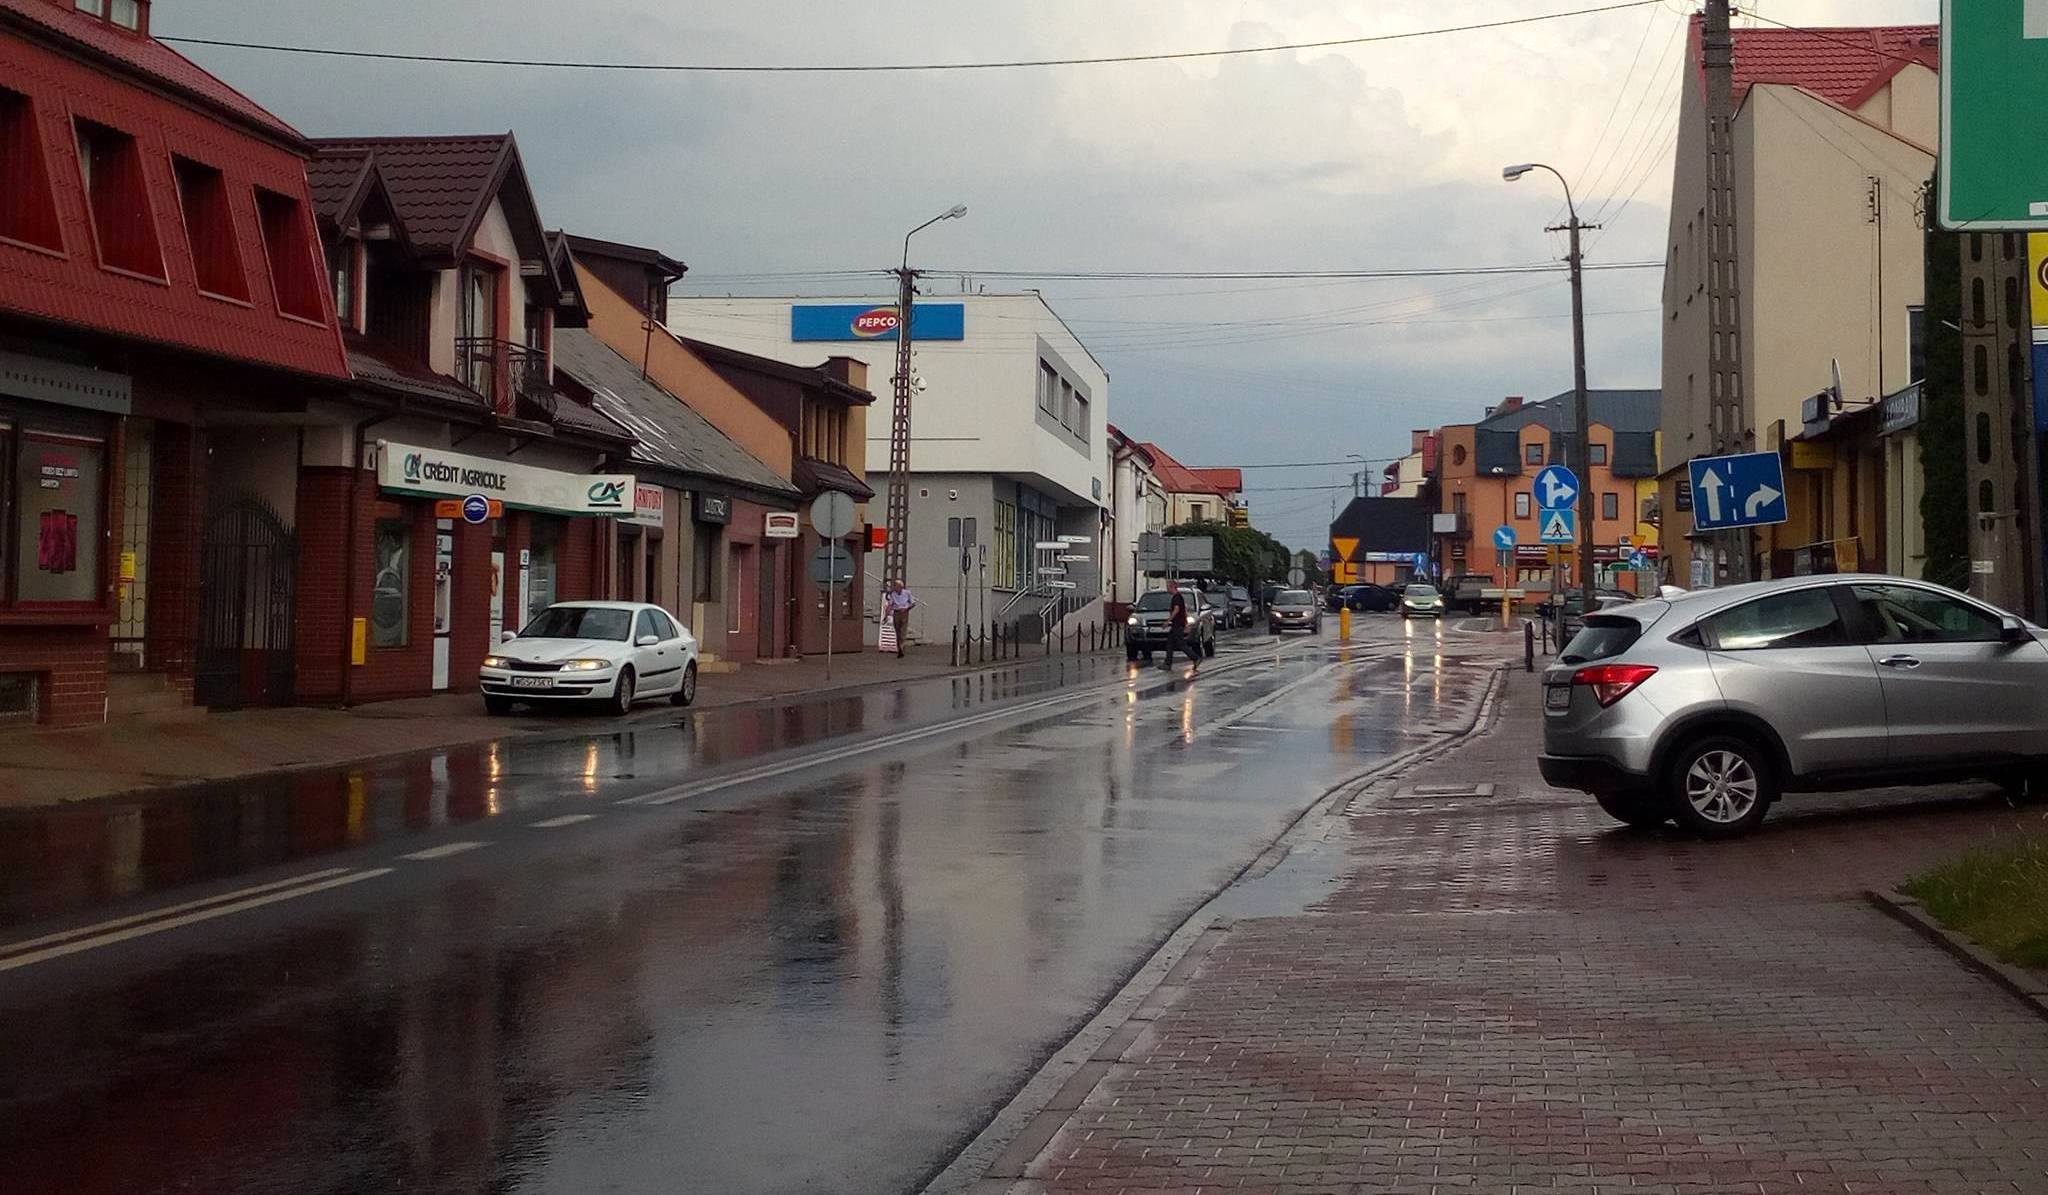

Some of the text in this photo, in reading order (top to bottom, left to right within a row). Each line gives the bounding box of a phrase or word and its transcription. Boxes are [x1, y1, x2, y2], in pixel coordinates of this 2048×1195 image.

[859, 317, 896, 327] PEPCO
[423, 461, 460, 483] CRÉDIT
[460, 468, 507, 491] AGRICOLE
